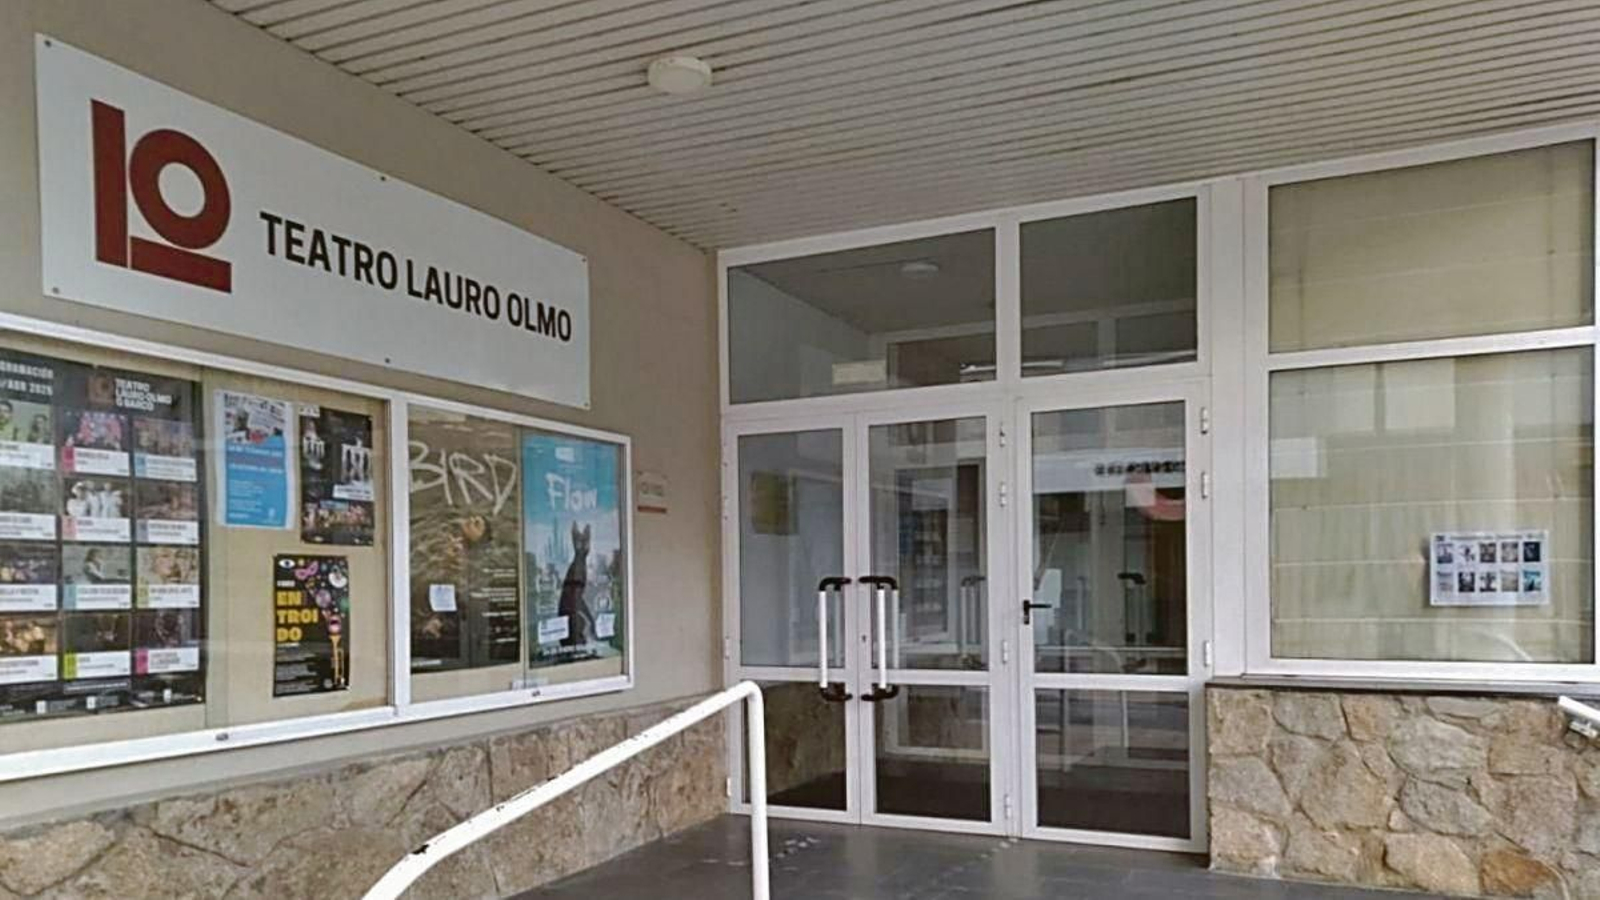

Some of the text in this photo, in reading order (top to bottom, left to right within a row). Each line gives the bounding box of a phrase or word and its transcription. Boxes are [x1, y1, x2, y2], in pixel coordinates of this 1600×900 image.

[259, 211, 572, 343] TEATRO LAURO OLMO
[408, 440, 516, 515] BIRD
[545, 472, 598, 511] Flow
[276, 590, 302, 606] EN
[276, 608, 319, 625] TROI
[276, 626, 303, 642] DO
